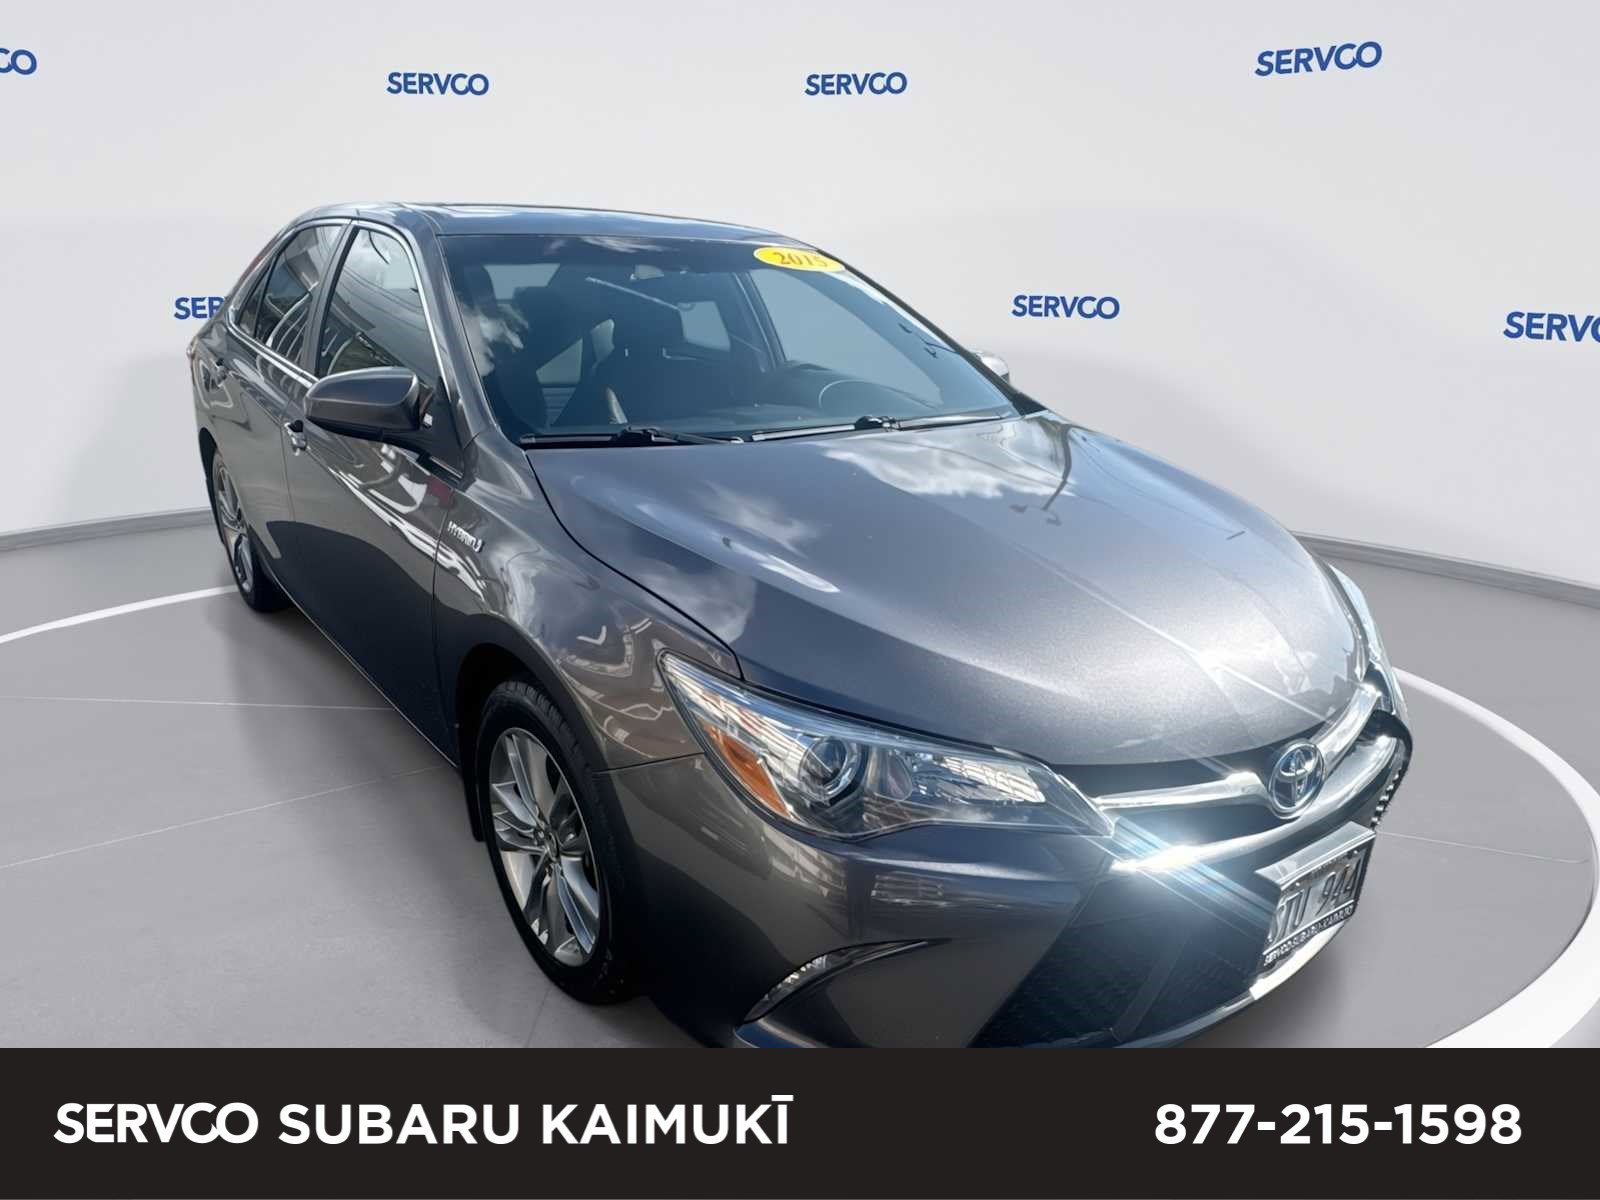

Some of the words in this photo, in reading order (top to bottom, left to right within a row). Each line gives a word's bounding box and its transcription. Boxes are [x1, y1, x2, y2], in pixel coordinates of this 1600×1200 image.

[1255, 41, 1382, 76] SERVCO
[386, 71, 489, 97] SERVCO
[805, 71, 908, 97] SERVCO
[774, 251, 828, 268] 2015
[1012, 294, 1120, 320] SERVCO
